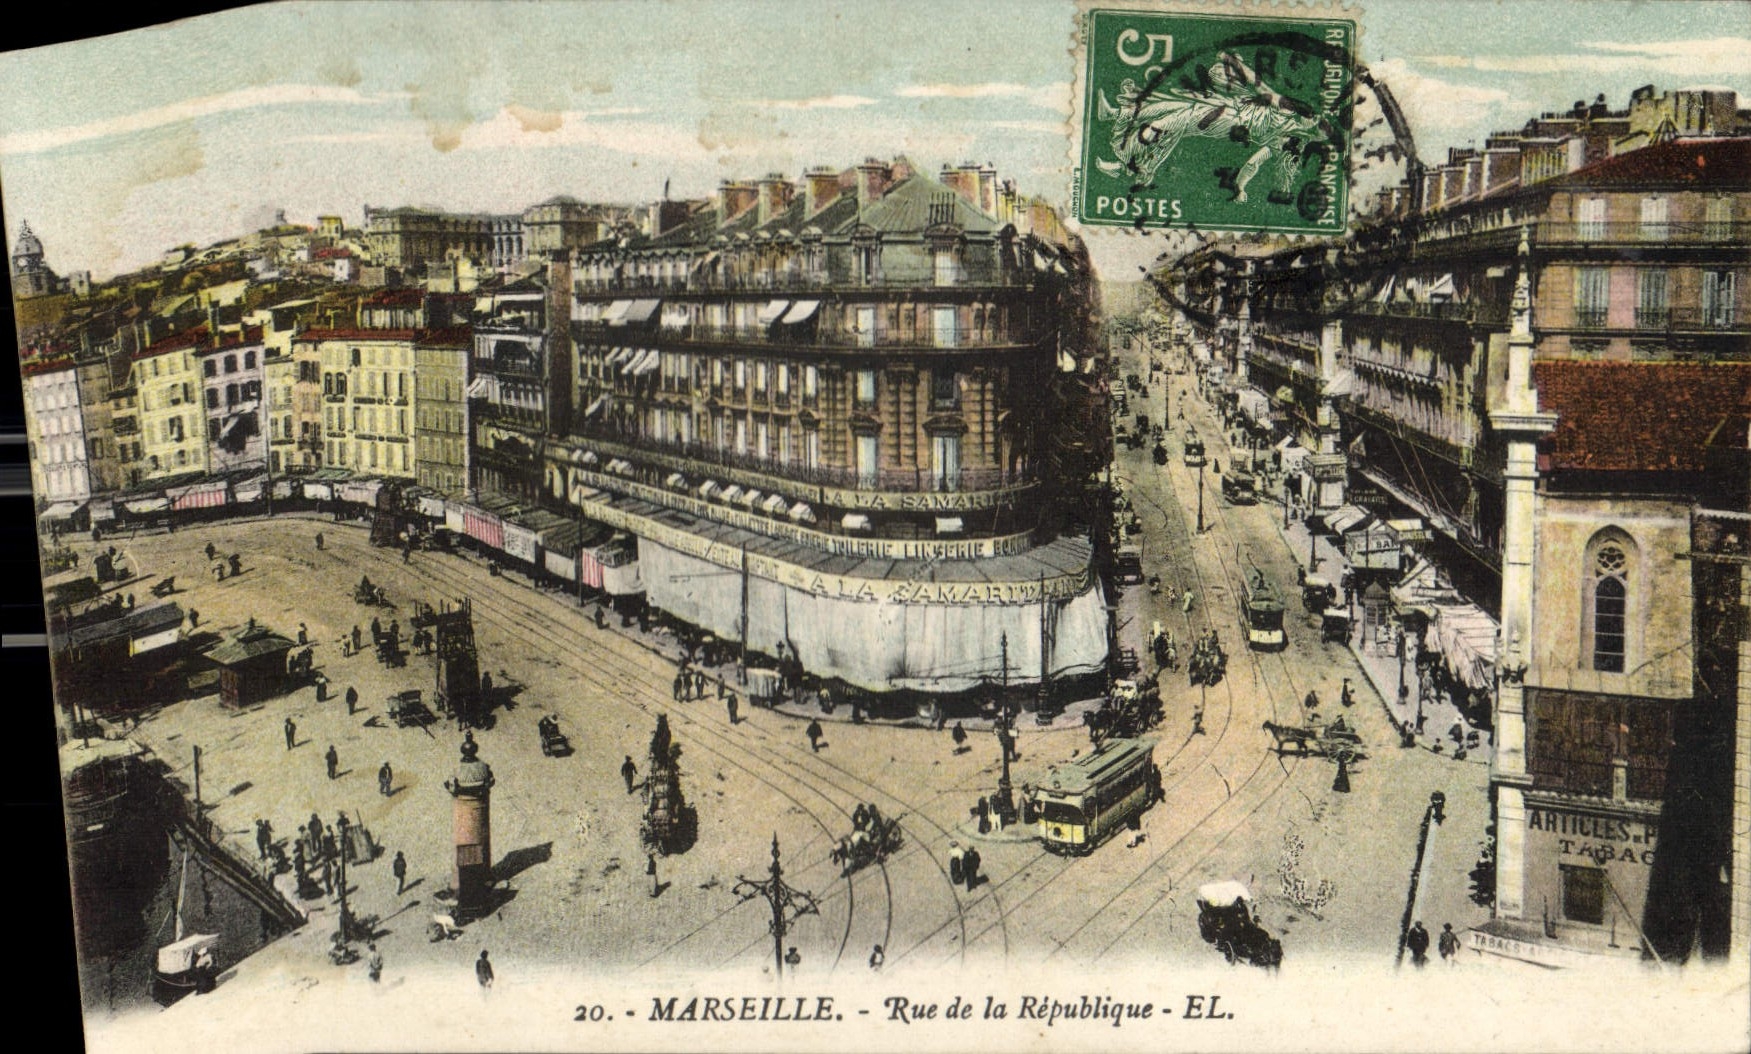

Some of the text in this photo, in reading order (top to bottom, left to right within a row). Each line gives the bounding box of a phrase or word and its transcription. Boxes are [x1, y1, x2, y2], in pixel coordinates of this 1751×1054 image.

[1117, 28, 1173, 66] 5
[1096, 195, 1182, 219] POSTES
[904, 541, 984, 561] LINGERIE
[838, 578, 875, 601] LA
[1528, 809, 1632, 842] ARTICLES
